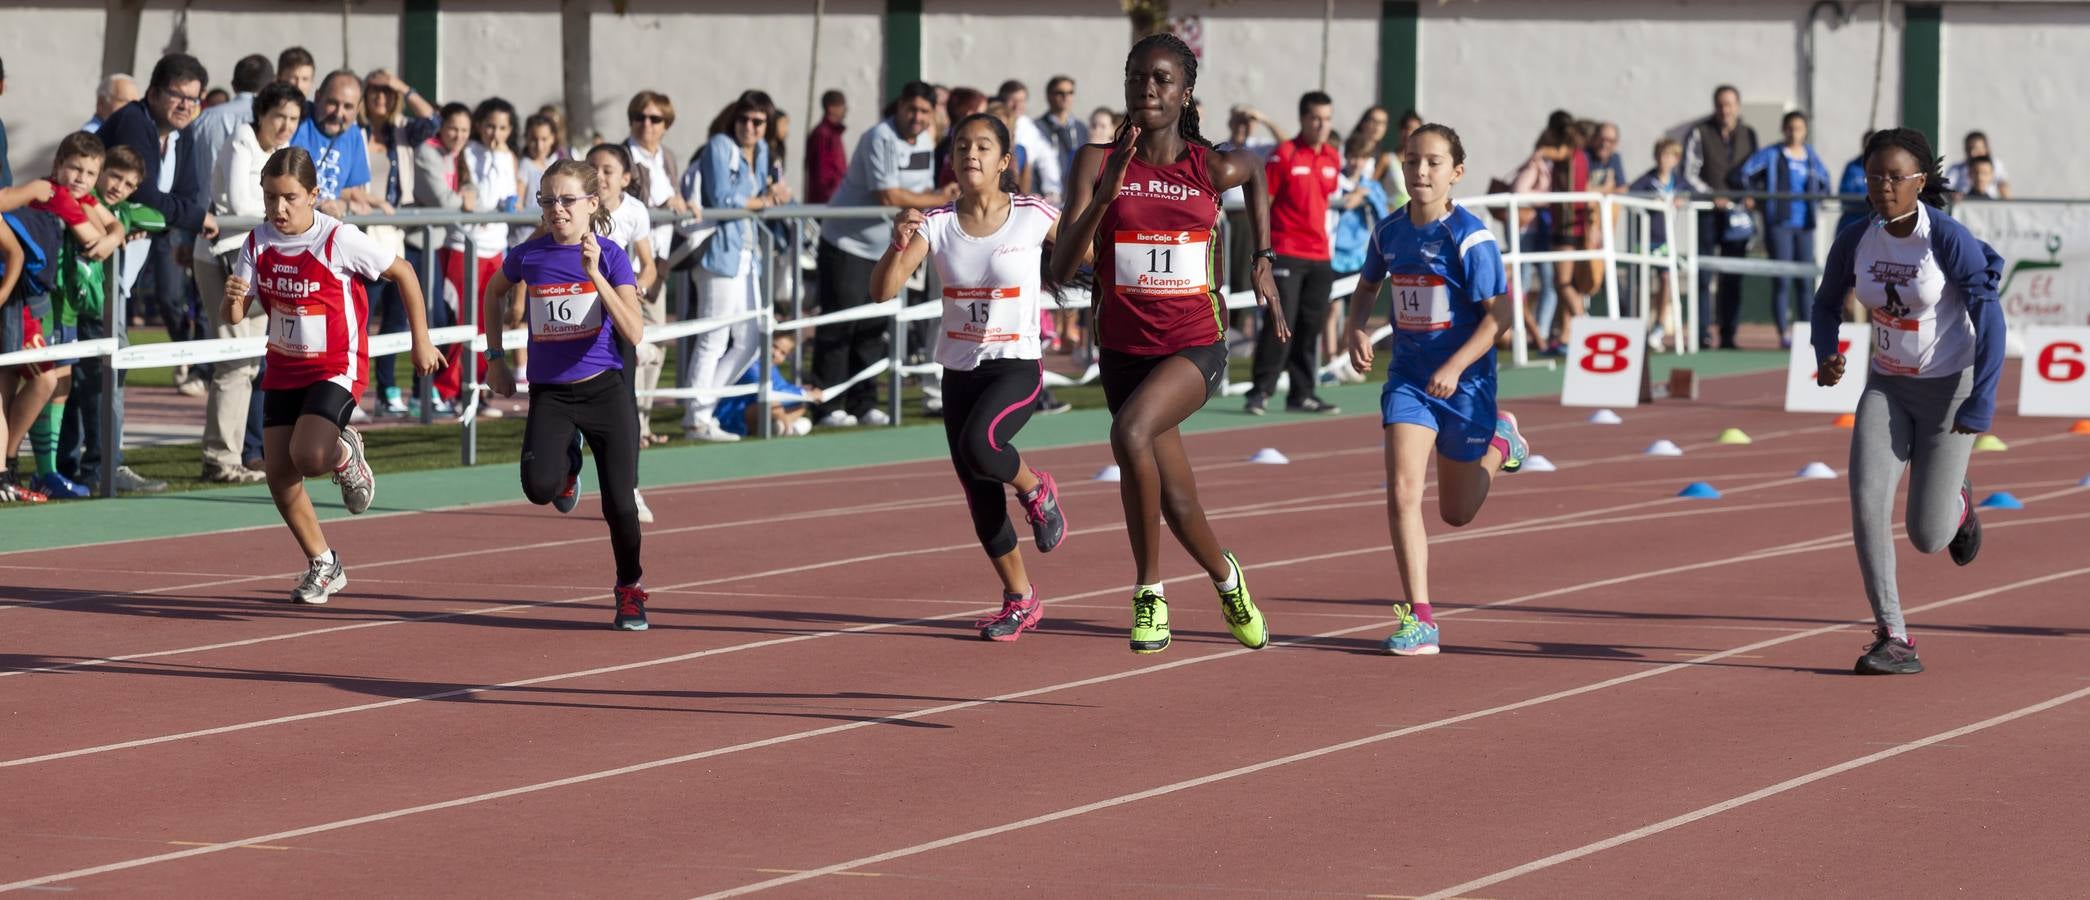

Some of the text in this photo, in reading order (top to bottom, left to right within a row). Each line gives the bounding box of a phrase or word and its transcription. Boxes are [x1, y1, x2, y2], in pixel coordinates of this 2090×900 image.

[1118, 191, 1180, 201] ATLETISMO
[1148, 180, 1200, 201] Rioja
[1146, 248, 1173, 273] 11
[256, 273, 321, 298] La Rioja
[545, 298, 572, 322] 16
[1399, 290, 1419, 311] 14
[967, 302, 990, 324] 15
[280, 317, 295, 339] 17
[1876, 326, 1890, 351] 13
[1579, 332, 1629, 374] 8
[2037, 341, 2086, 383] 6
